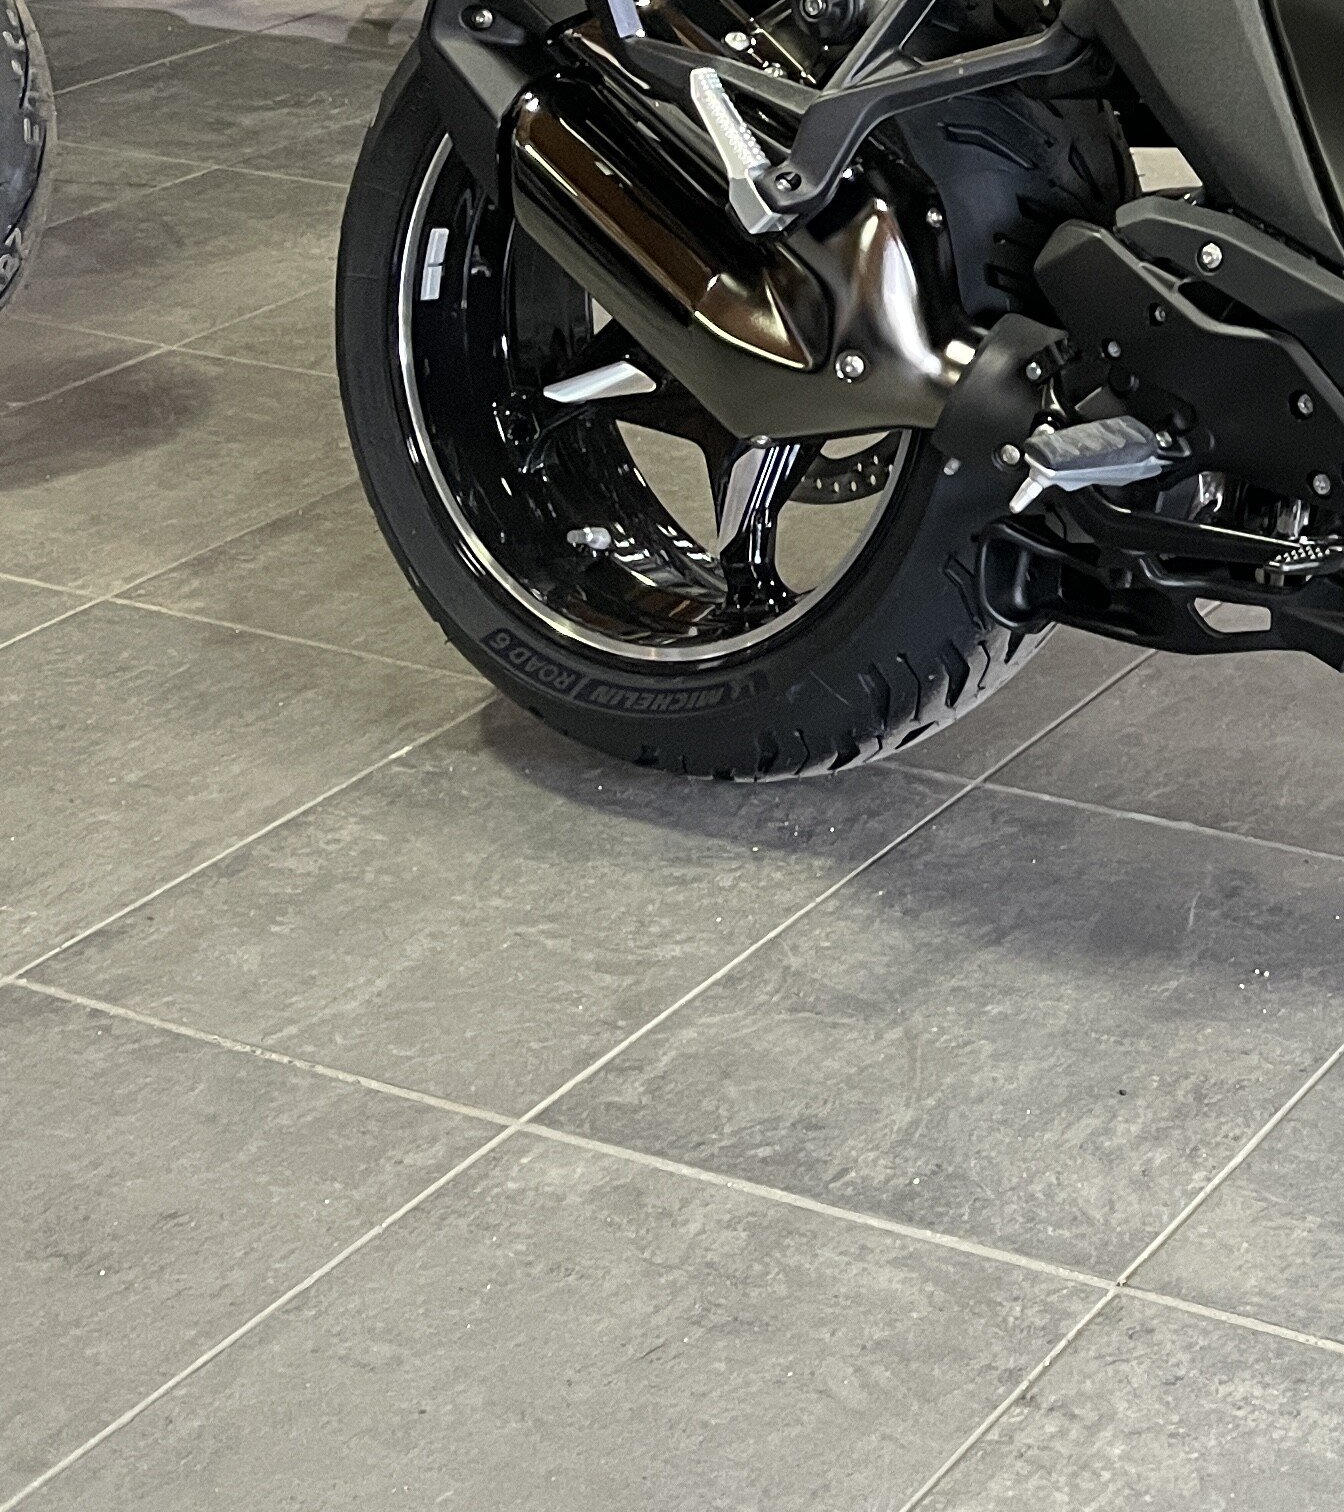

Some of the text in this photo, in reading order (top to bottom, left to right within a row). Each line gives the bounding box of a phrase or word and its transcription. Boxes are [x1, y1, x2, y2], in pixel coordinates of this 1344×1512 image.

[491, 631, 725, 712] MICHELIN ROAD 6
